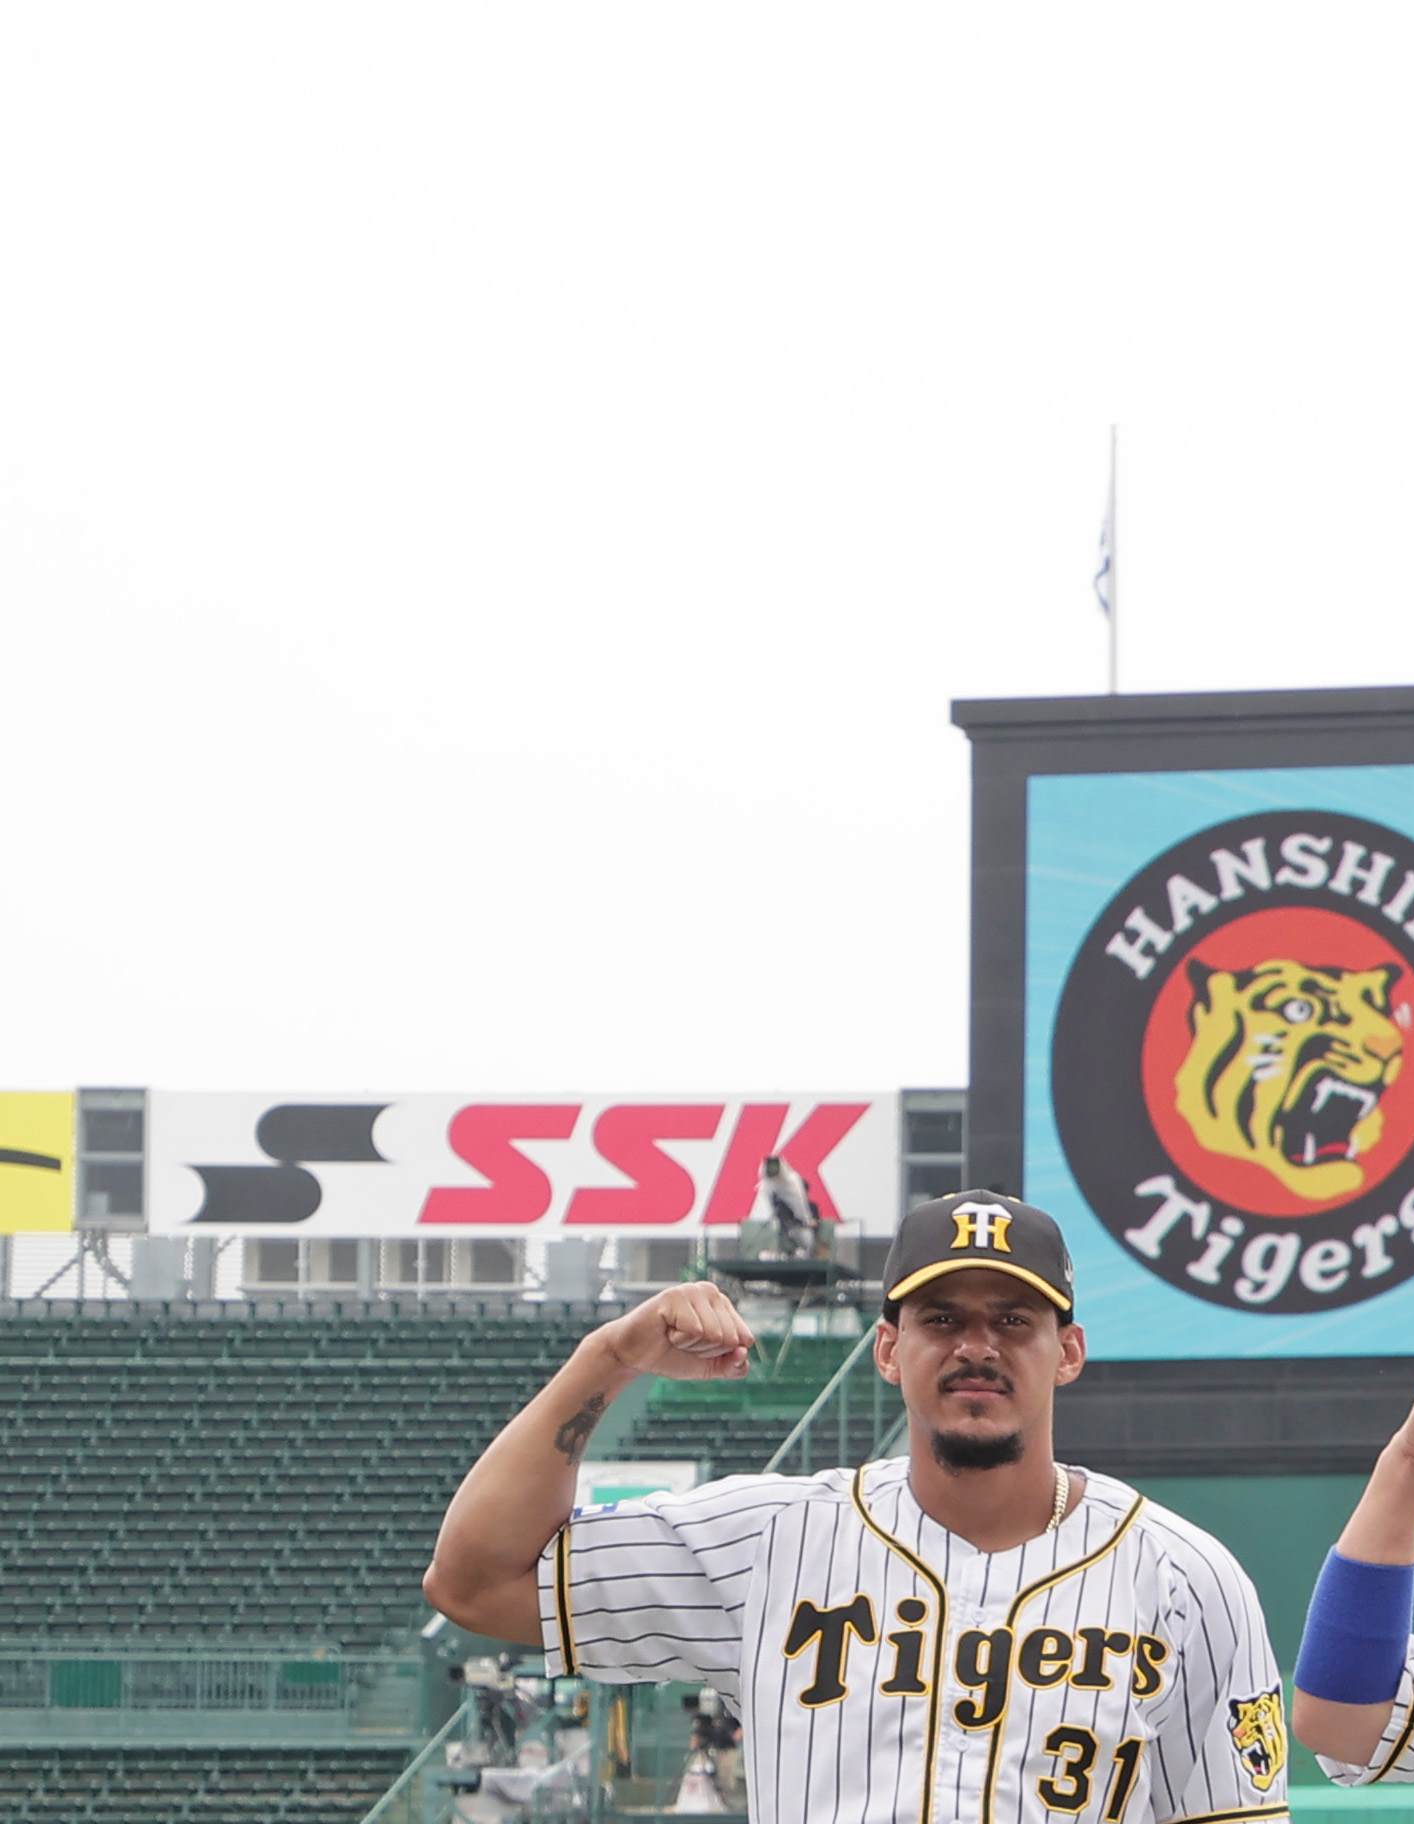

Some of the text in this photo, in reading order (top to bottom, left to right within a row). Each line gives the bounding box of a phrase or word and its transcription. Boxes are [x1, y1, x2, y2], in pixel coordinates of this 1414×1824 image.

[417, 1103, 872, 1225] SSK
[783, 1593, 1170, 1731] Tigers
[1037, 1723, 1145, 1824] 31
